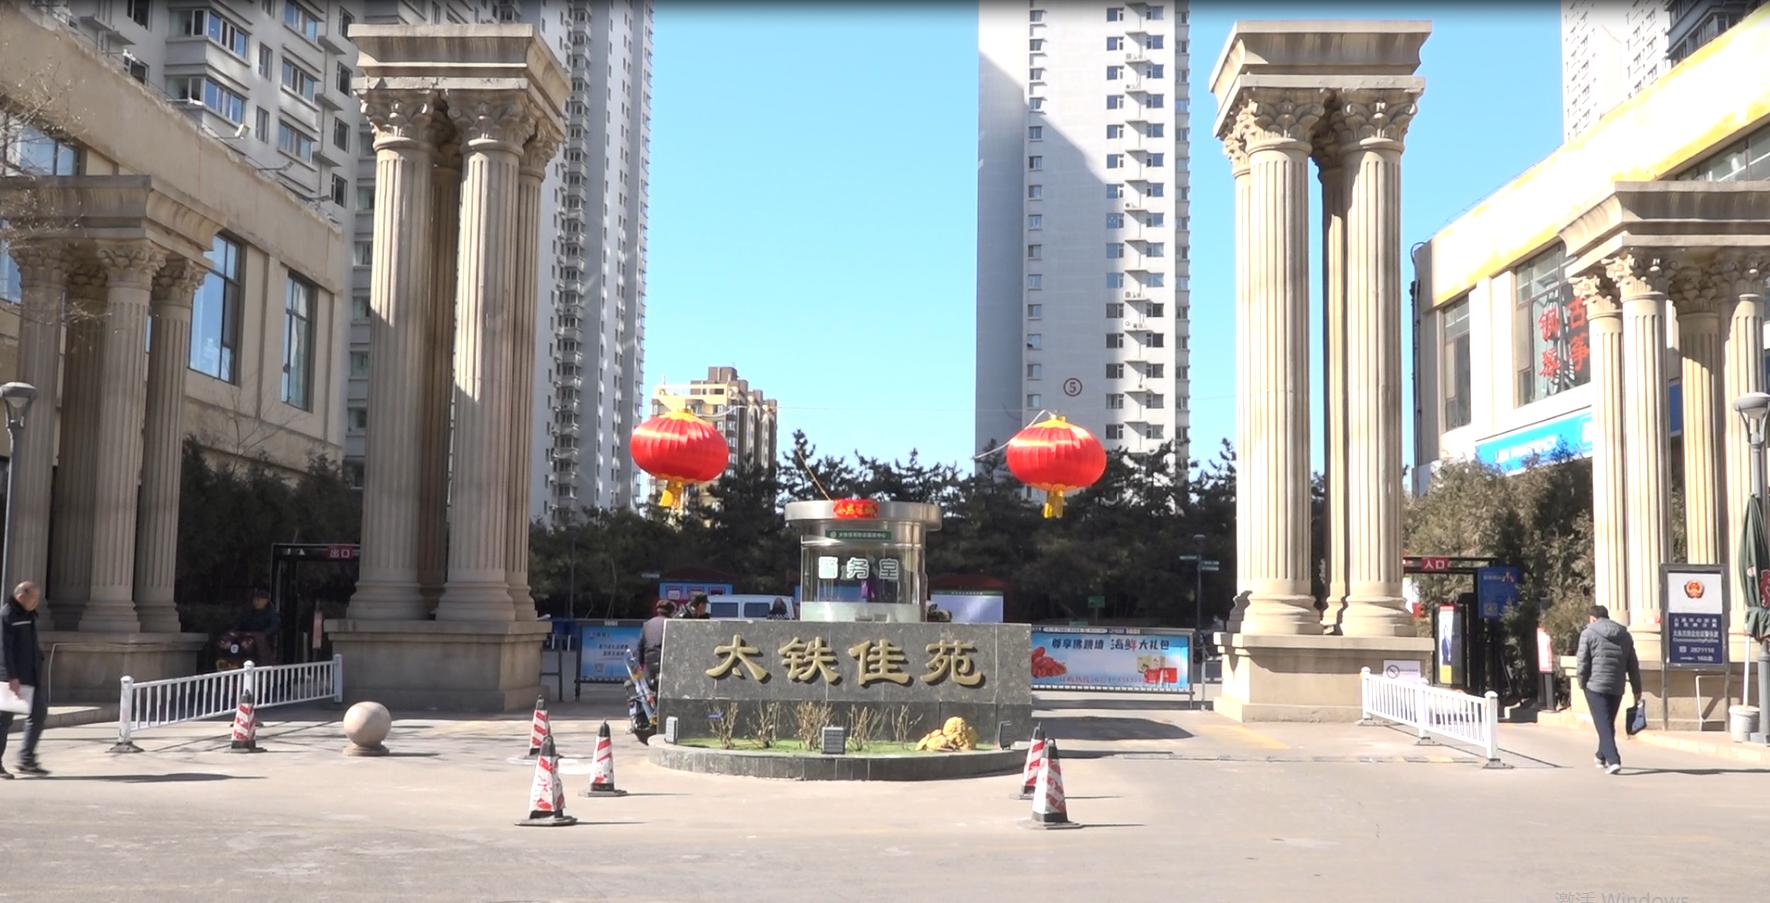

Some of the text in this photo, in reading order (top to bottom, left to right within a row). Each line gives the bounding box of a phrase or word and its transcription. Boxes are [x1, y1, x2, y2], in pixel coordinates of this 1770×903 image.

[329, 548, 350, 559] 出口
[1423, 559, 1445, 569] 入口
[1110, 638, 1170, 651] 海鲜大礼包
[705, 634, 983, 687] 太铁佳苑
